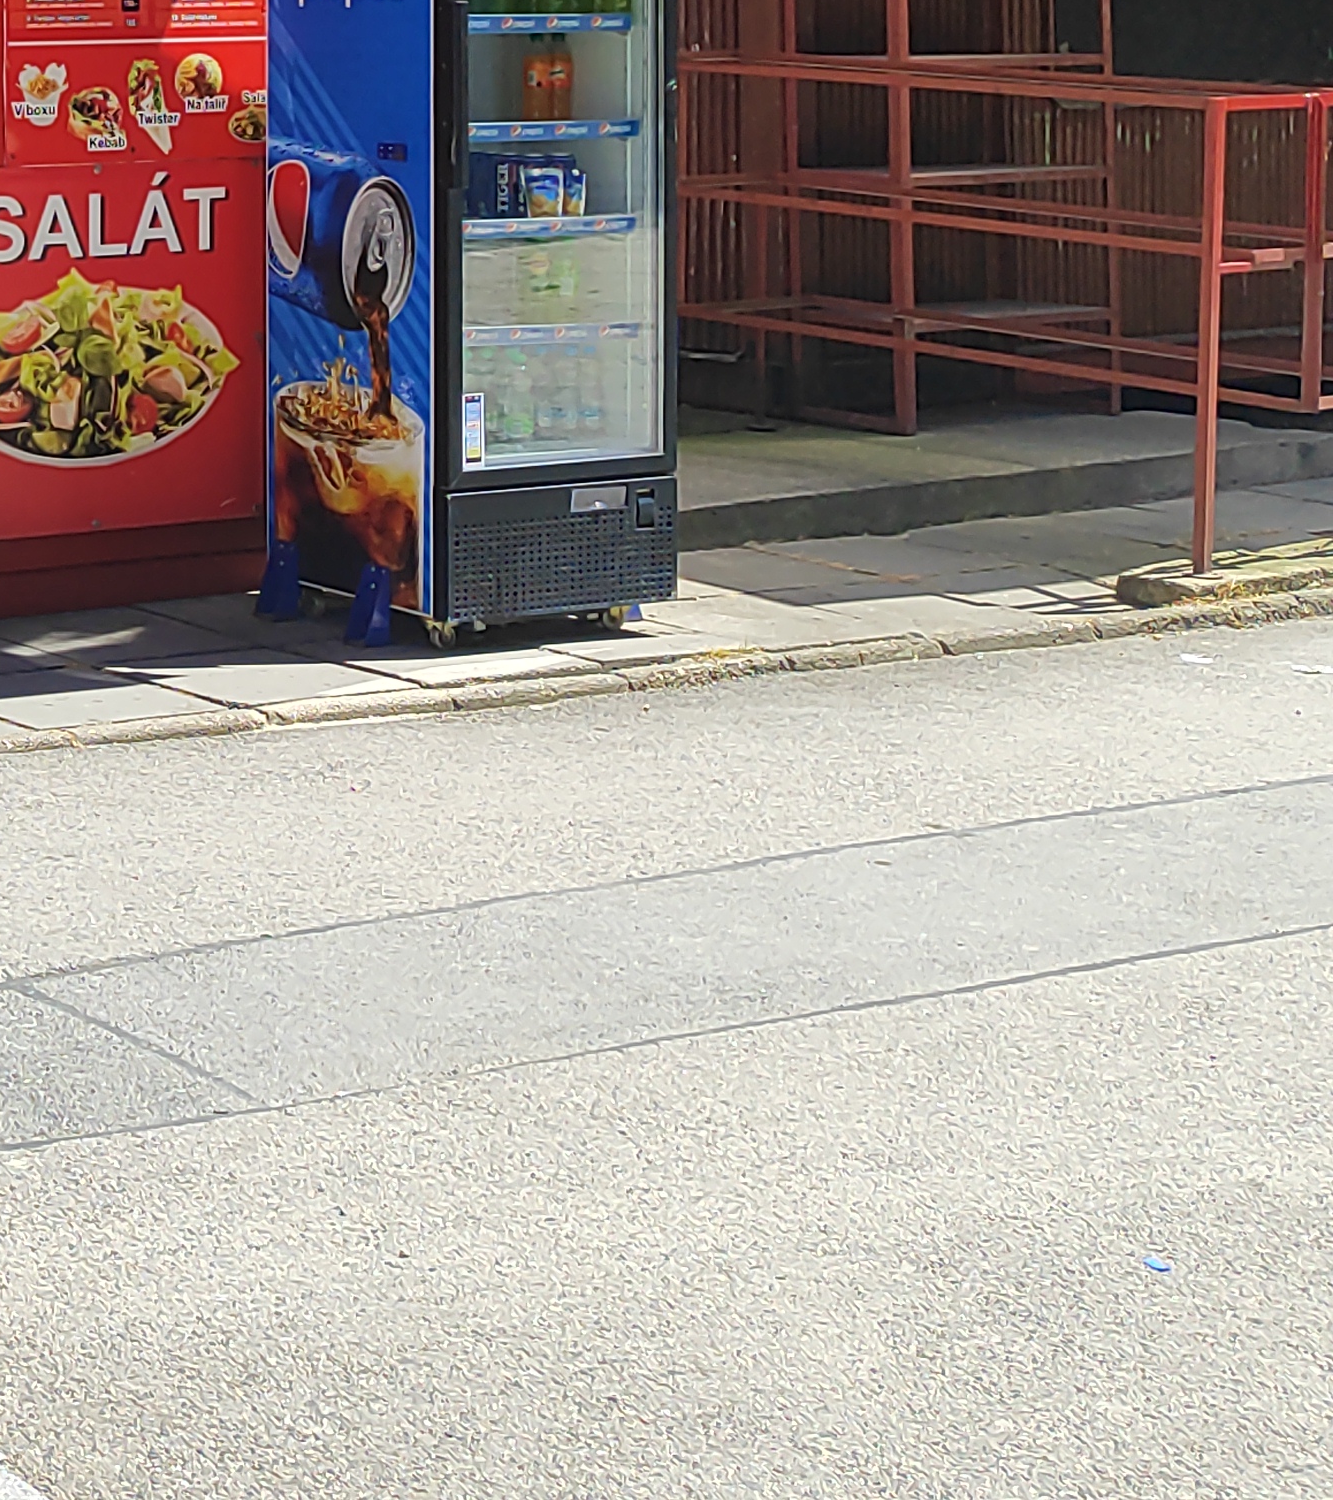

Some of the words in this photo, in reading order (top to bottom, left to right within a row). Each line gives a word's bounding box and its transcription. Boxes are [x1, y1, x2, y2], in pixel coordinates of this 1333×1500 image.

[14, 105, 23, 117] V
[25, 104, 56, 116] boxu
[187, 99, 202, 111] Na
[138, 113, 180, 126] Twister
[89, 136, 126, 149] Kebab
[496, 162, 509, 213] TIGER
